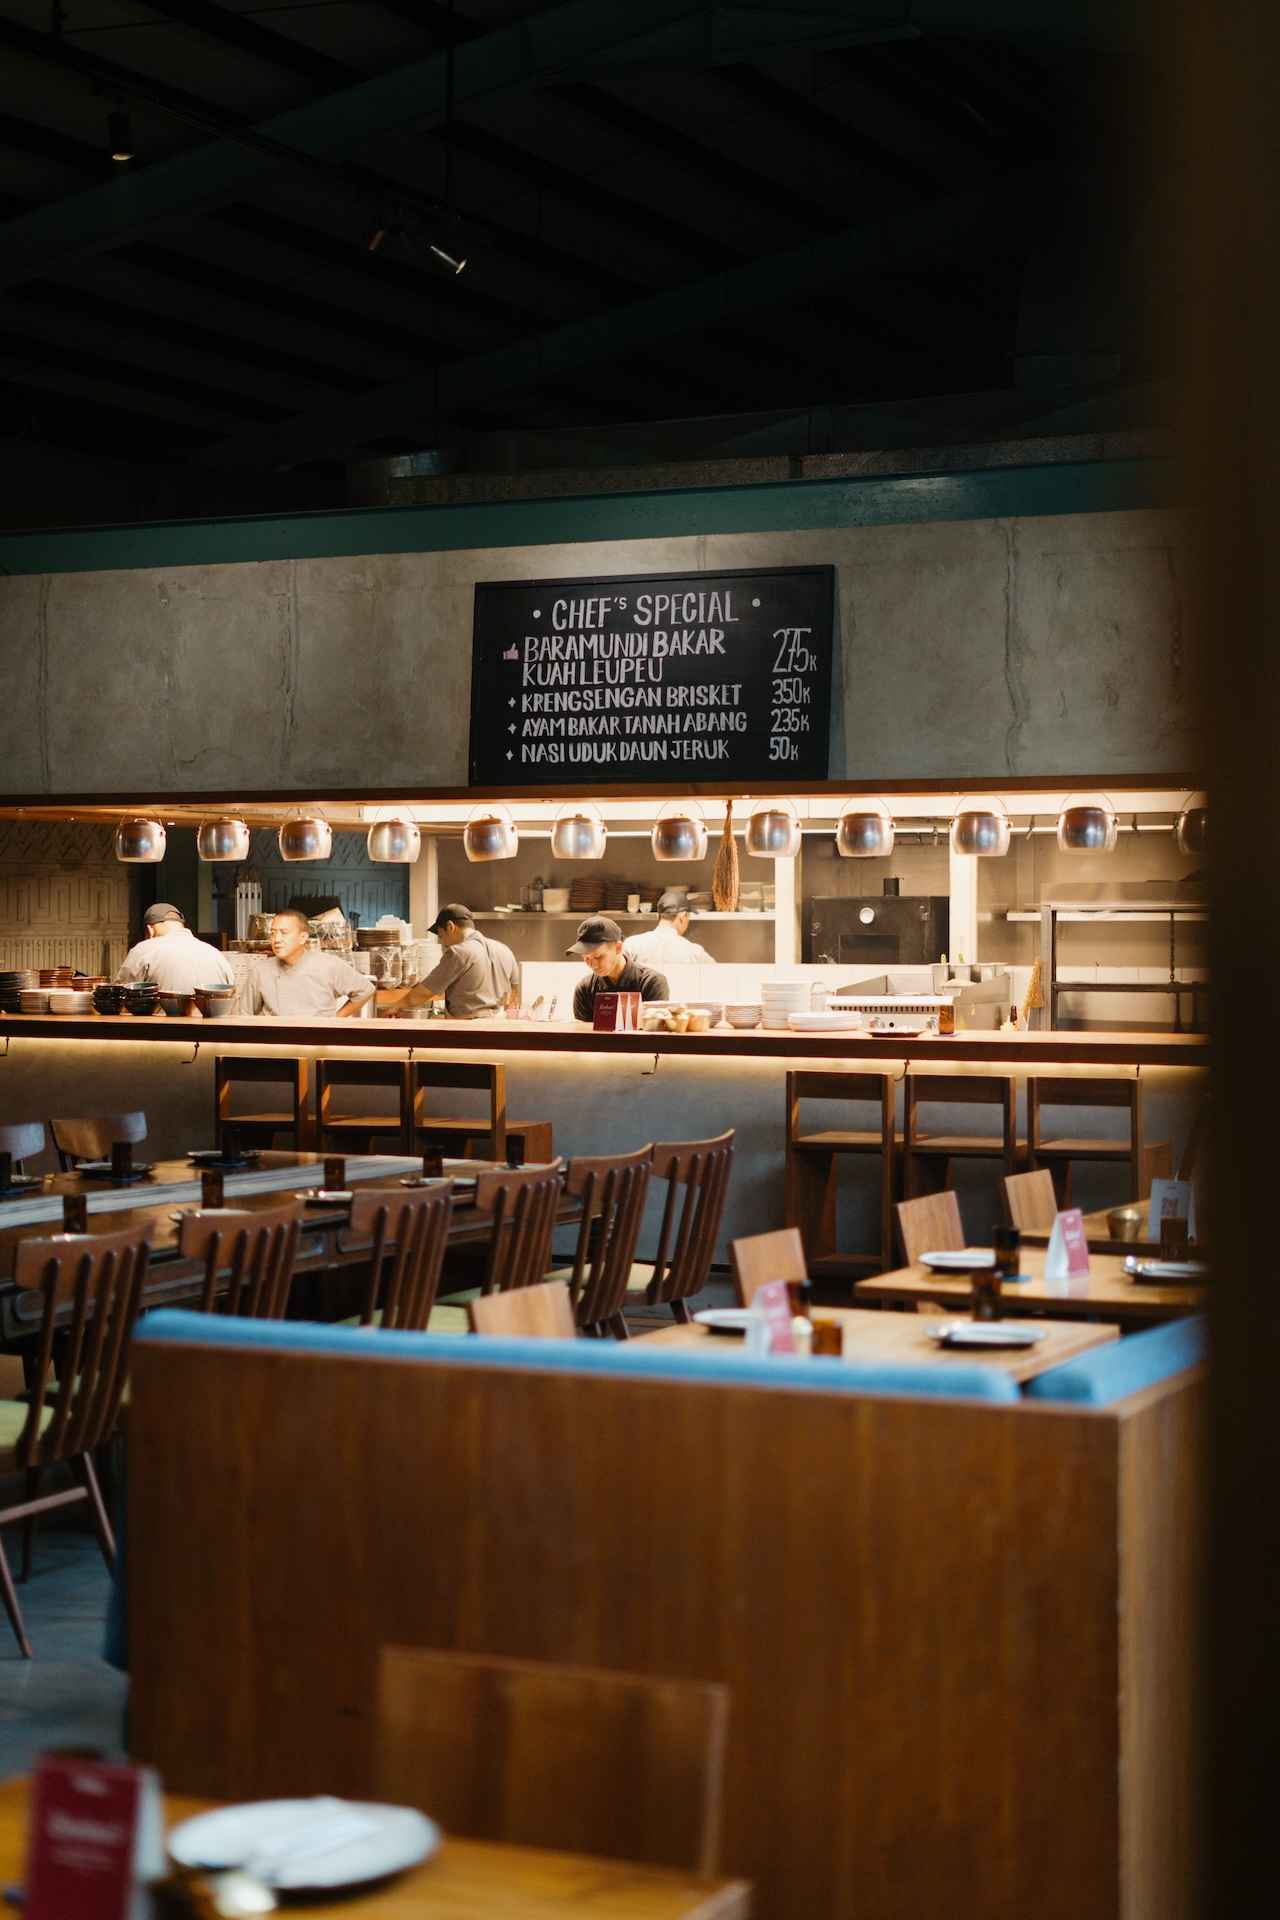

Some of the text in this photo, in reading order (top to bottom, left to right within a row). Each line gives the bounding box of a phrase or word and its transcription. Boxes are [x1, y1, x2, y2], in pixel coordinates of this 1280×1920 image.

[633, 590, 740, 626] SPECIAL
[524, 627, 727, 663] BARAMUNDI BAKAR
[522, 657, 663, 687] KUAH LEUPEU
[521, 686, 662, 713] KRENGSENGAN
[666, 683, 743, 708] BRISKET
[521, 717, 566, 737] AYAM
[567, 715, 622, 737] BAKAR
[623, 713, 680, 736] TANAH
[682, 711, 748, 733] ABANG
[521, 742, 565, 764] NASI
[568, 741, 618, 764] UDUK
[620, 739, 668, 762] DAUN
[670, 738, 730, 761] JERUK
